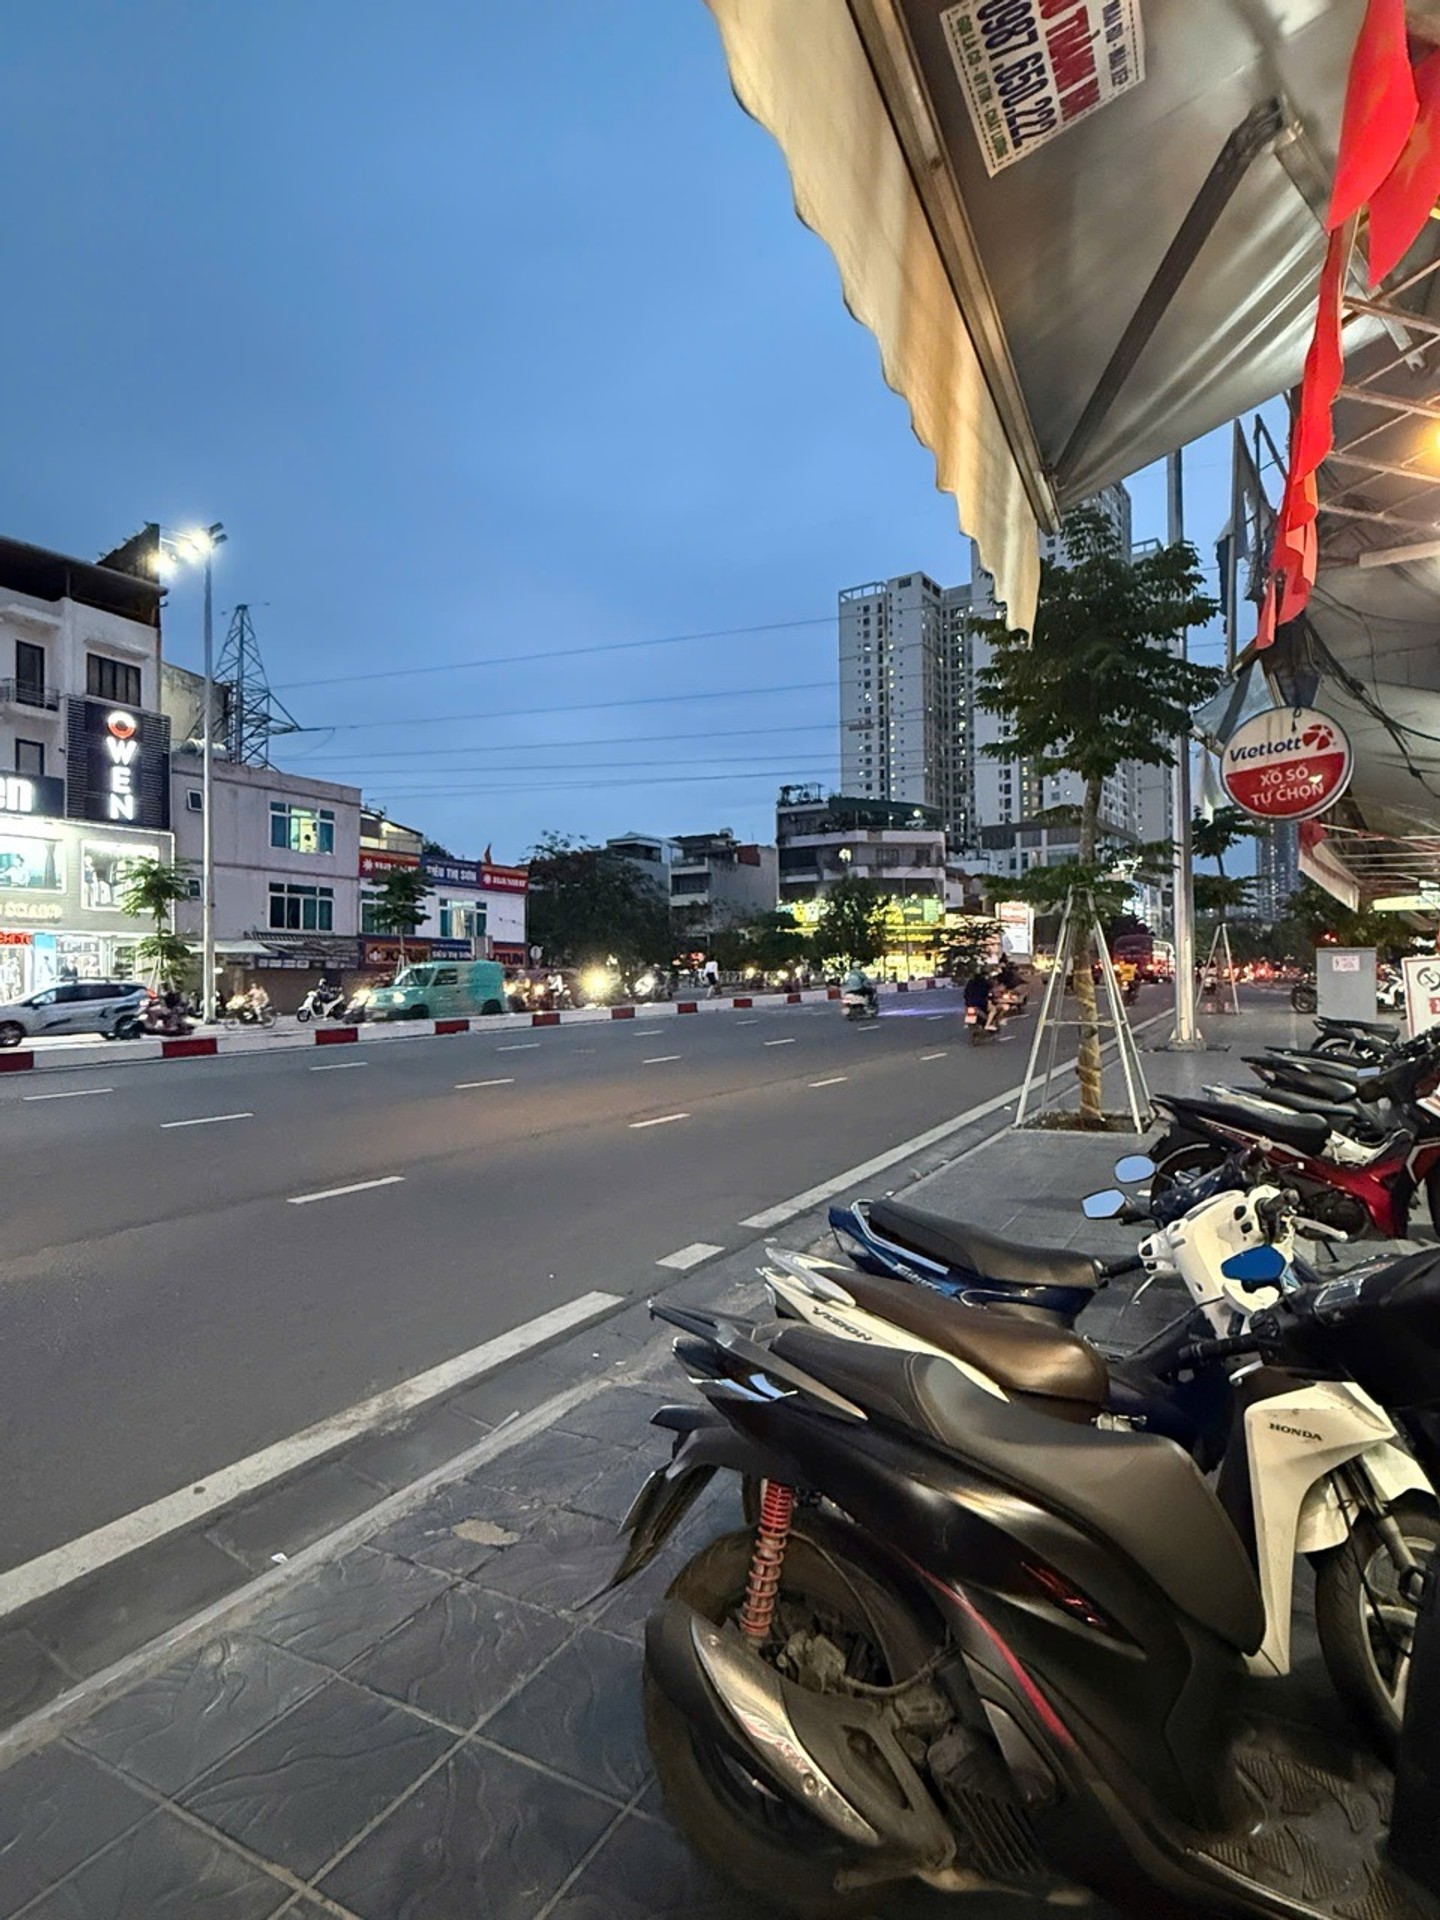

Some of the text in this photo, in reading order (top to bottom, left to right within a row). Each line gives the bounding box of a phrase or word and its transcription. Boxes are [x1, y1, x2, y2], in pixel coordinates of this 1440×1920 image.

[1230, 737, 1301, 762] Vietlott
[107, 710, 137, 820] OWEN
[1285, 763, 1309, 782] SỐ
[1251, 783, 1325, 807] TỰ CHỌN
[1269, 1422, 1323, 1441] HONDA
